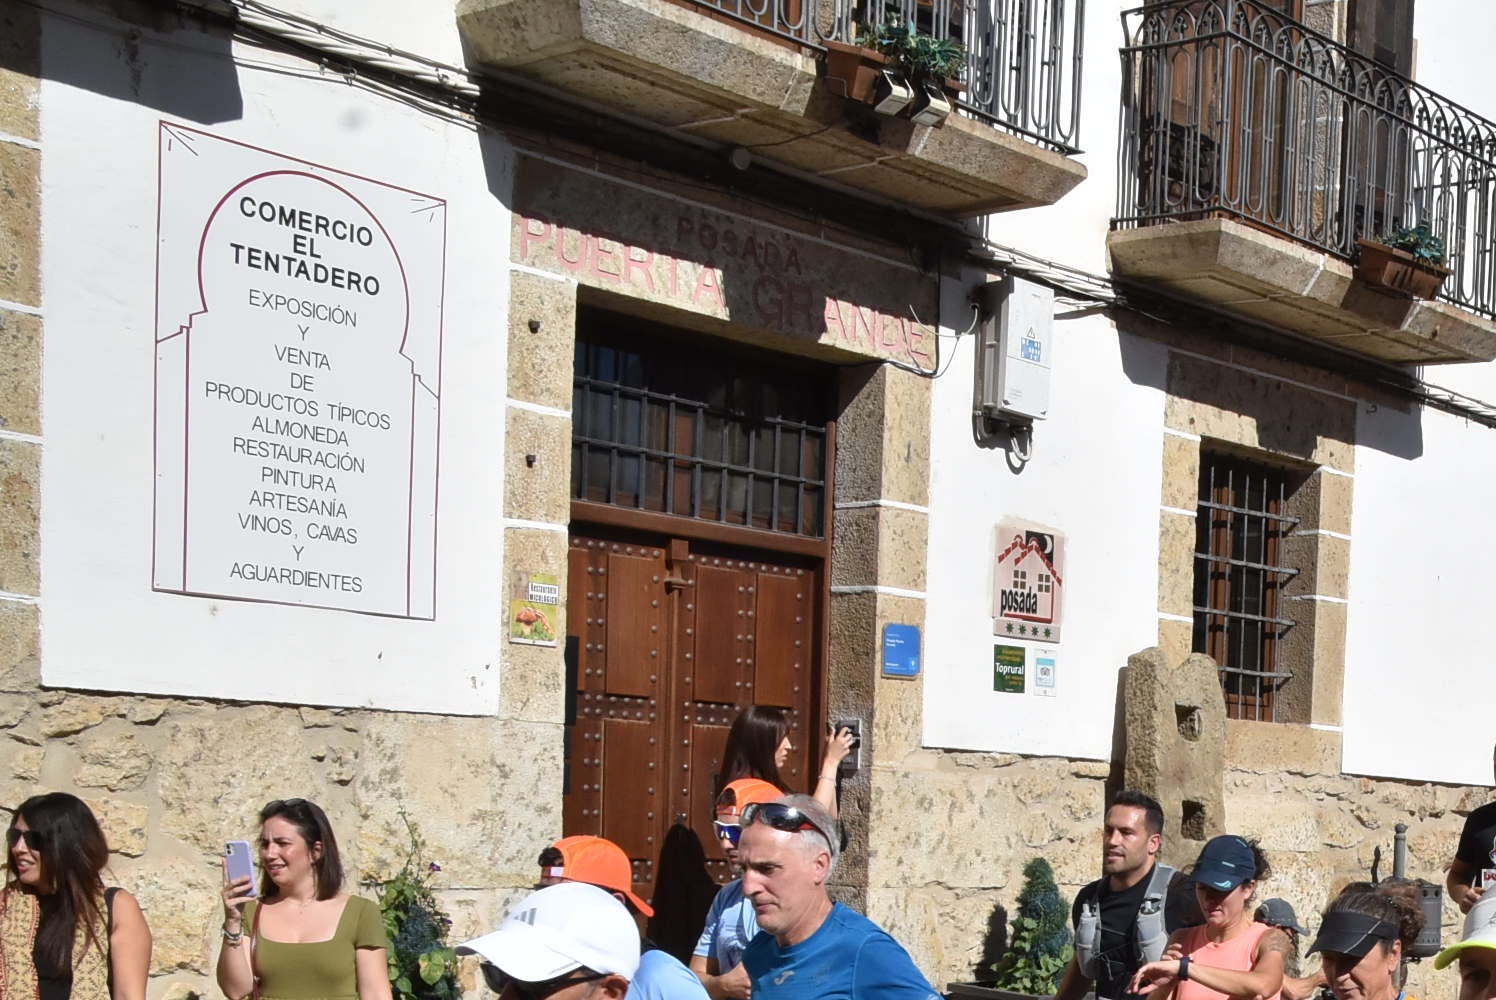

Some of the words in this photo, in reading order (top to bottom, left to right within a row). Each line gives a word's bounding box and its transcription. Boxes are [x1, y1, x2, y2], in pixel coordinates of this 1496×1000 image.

[240, 196, 373, 247] COMERCIO
[293, 234, 322, 259] EL
[676, 216, 802, 276] POSADA
[230, 242, 380, 296] TENTADERO
[520, 214, 726, 310] PUERTA
[752, 275, 929, 361] GRANDE
[249, 288, 357, 327] EXPOSICIÓN
[298, 324, 310, 341] Y
[274, 344, 331, 371] VENTA
[290, 372, 314, 392] DE
[205, 381, 319, 417] PRODUCTOS
[327, 402, 391, 430] TÍPICOS
[251, 415, 349, 447] ALMONEDA
[233, 436, 365, 474] RESTAURACIÓN
[261, 466, 337, 493] PINTURA
[249, 490, 348, 519] ARTESANÍA
[238, 513, 298, 539] VINOS,
[306, 522, 358, 545] CAVAS
[293, 545, 304, 561] Y
[230, 562, 363, 593] AGUARDIENTES
[1000, 586, 1037, 617] posada
[995, 662, 1024, 675] Toprural
